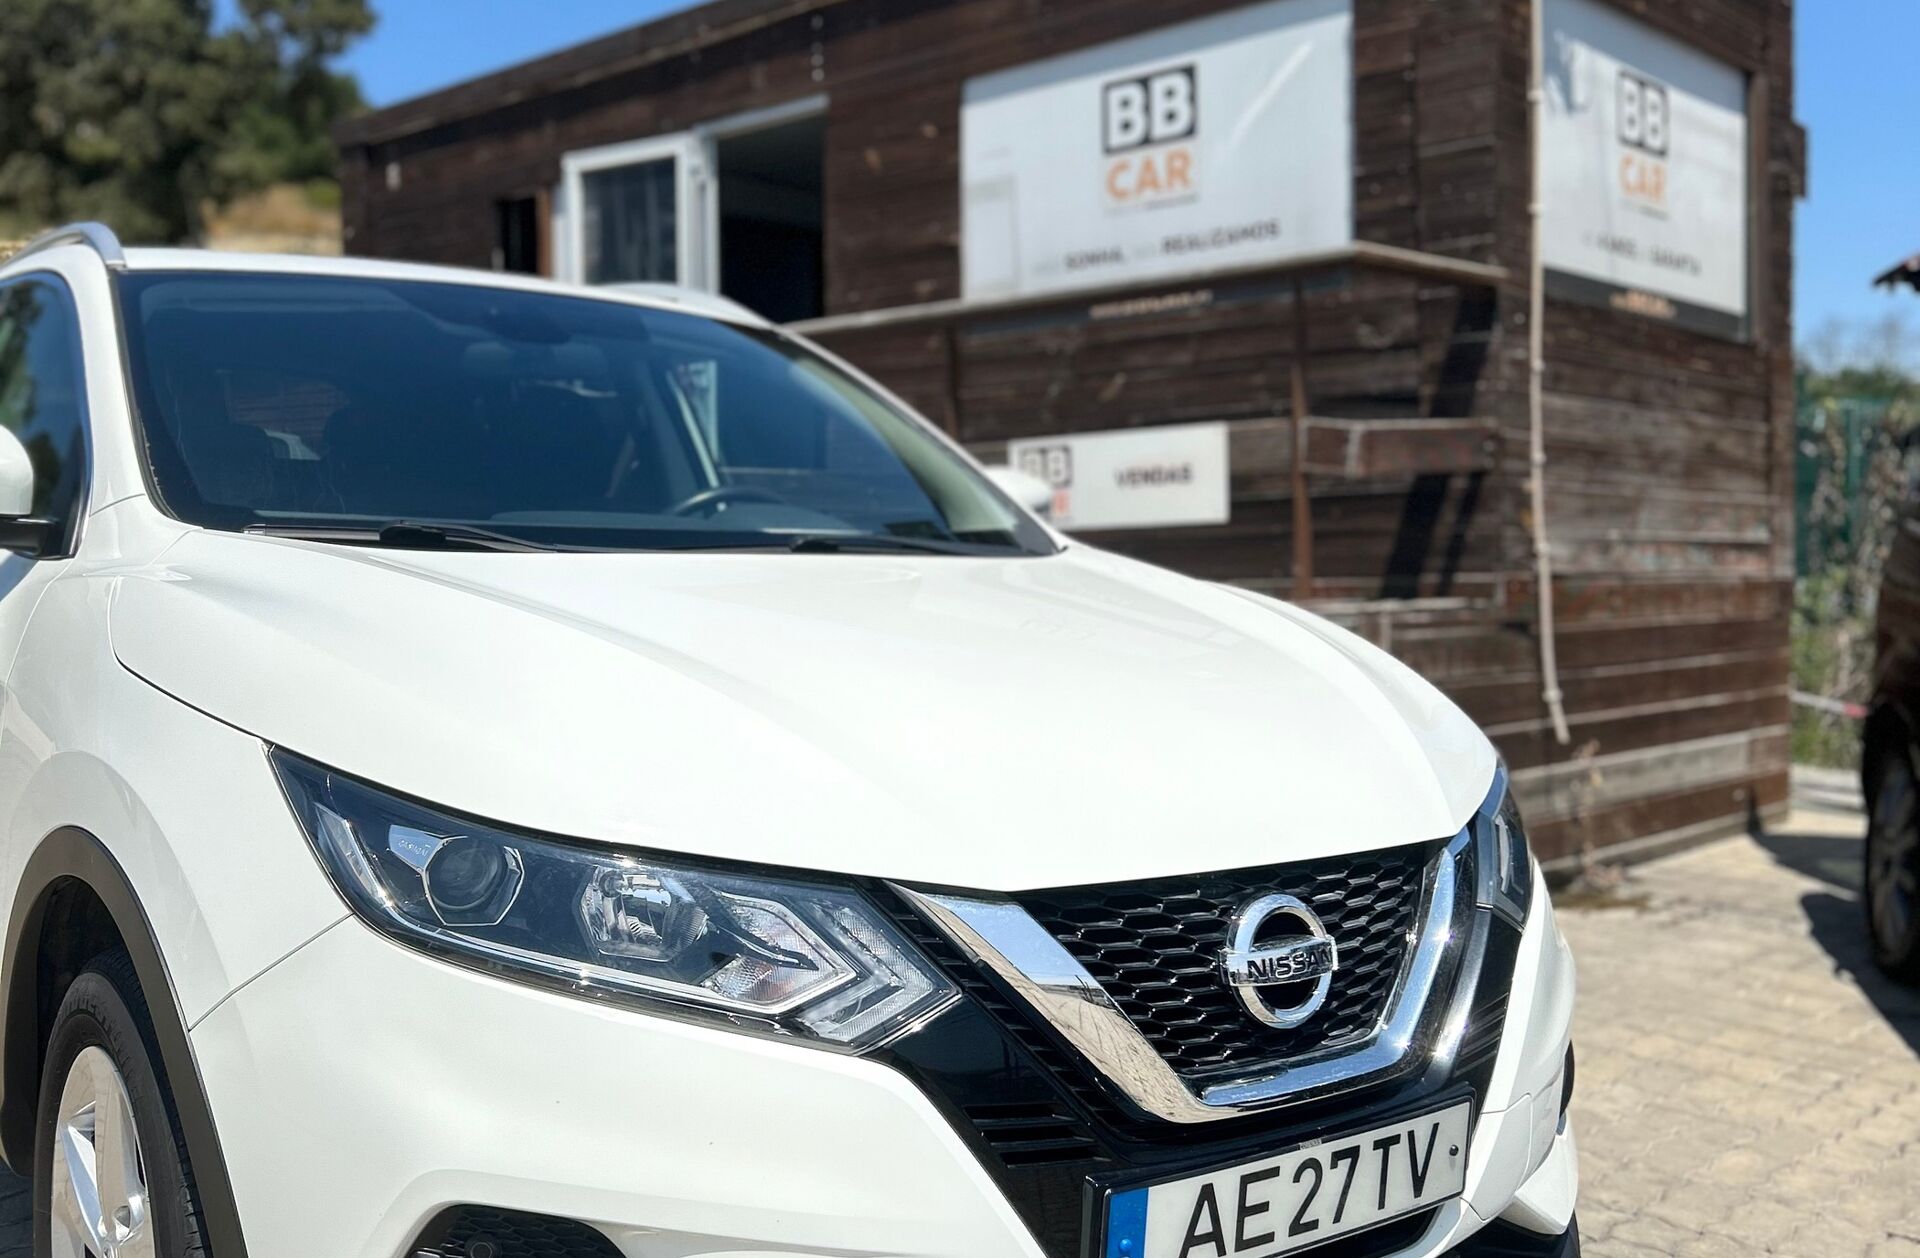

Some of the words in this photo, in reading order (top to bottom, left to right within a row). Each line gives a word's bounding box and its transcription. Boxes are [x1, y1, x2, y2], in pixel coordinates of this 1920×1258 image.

[1106, 70, 1195, 150] BB
[1619, 74, 1667, 153] BB
[1106, 149, 1191, 201] CAR
[1246, 945, 1332, 980] NISSAN
